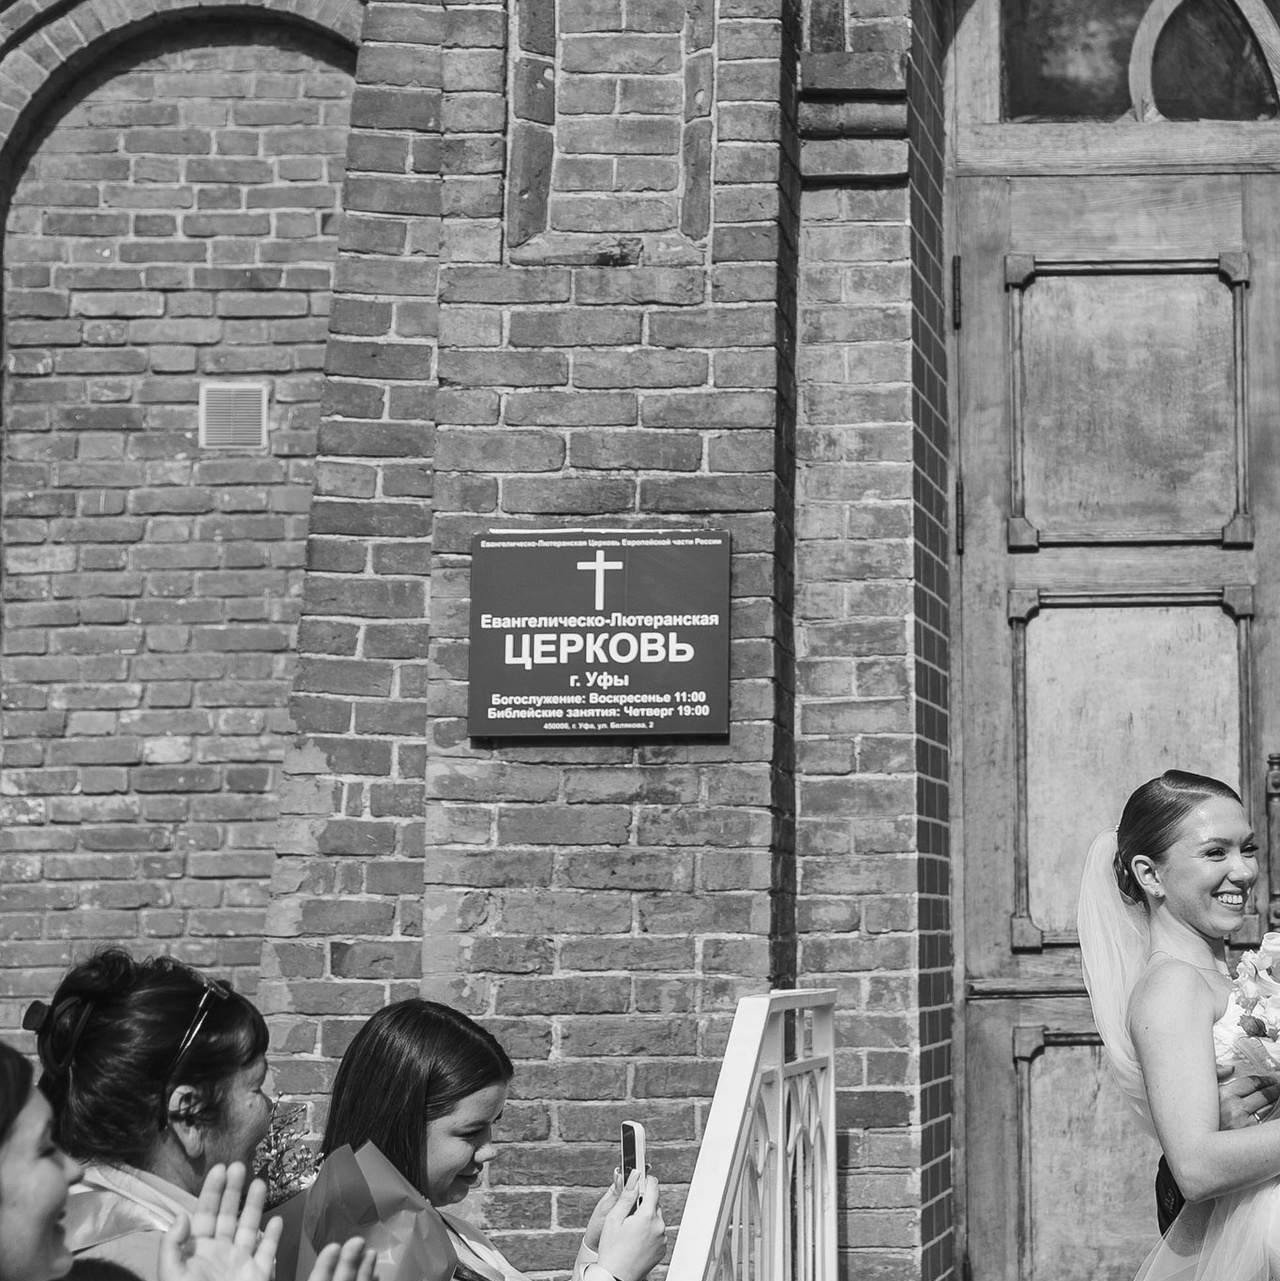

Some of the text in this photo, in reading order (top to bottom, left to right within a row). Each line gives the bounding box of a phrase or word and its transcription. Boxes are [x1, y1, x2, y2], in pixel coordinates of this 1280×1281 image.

[480, 612, 719, 629] Евангелическо-Лютеранская
[504, 632, 695, 670] ЦЕРКОВЬ
[569, 671, 629, 690] г. Уфы
[491, 691, 706, 707] Богослужение: Воскресенье 11:00
[487, 704, 710, 719] Библейские занятия: Четверг 19:00
